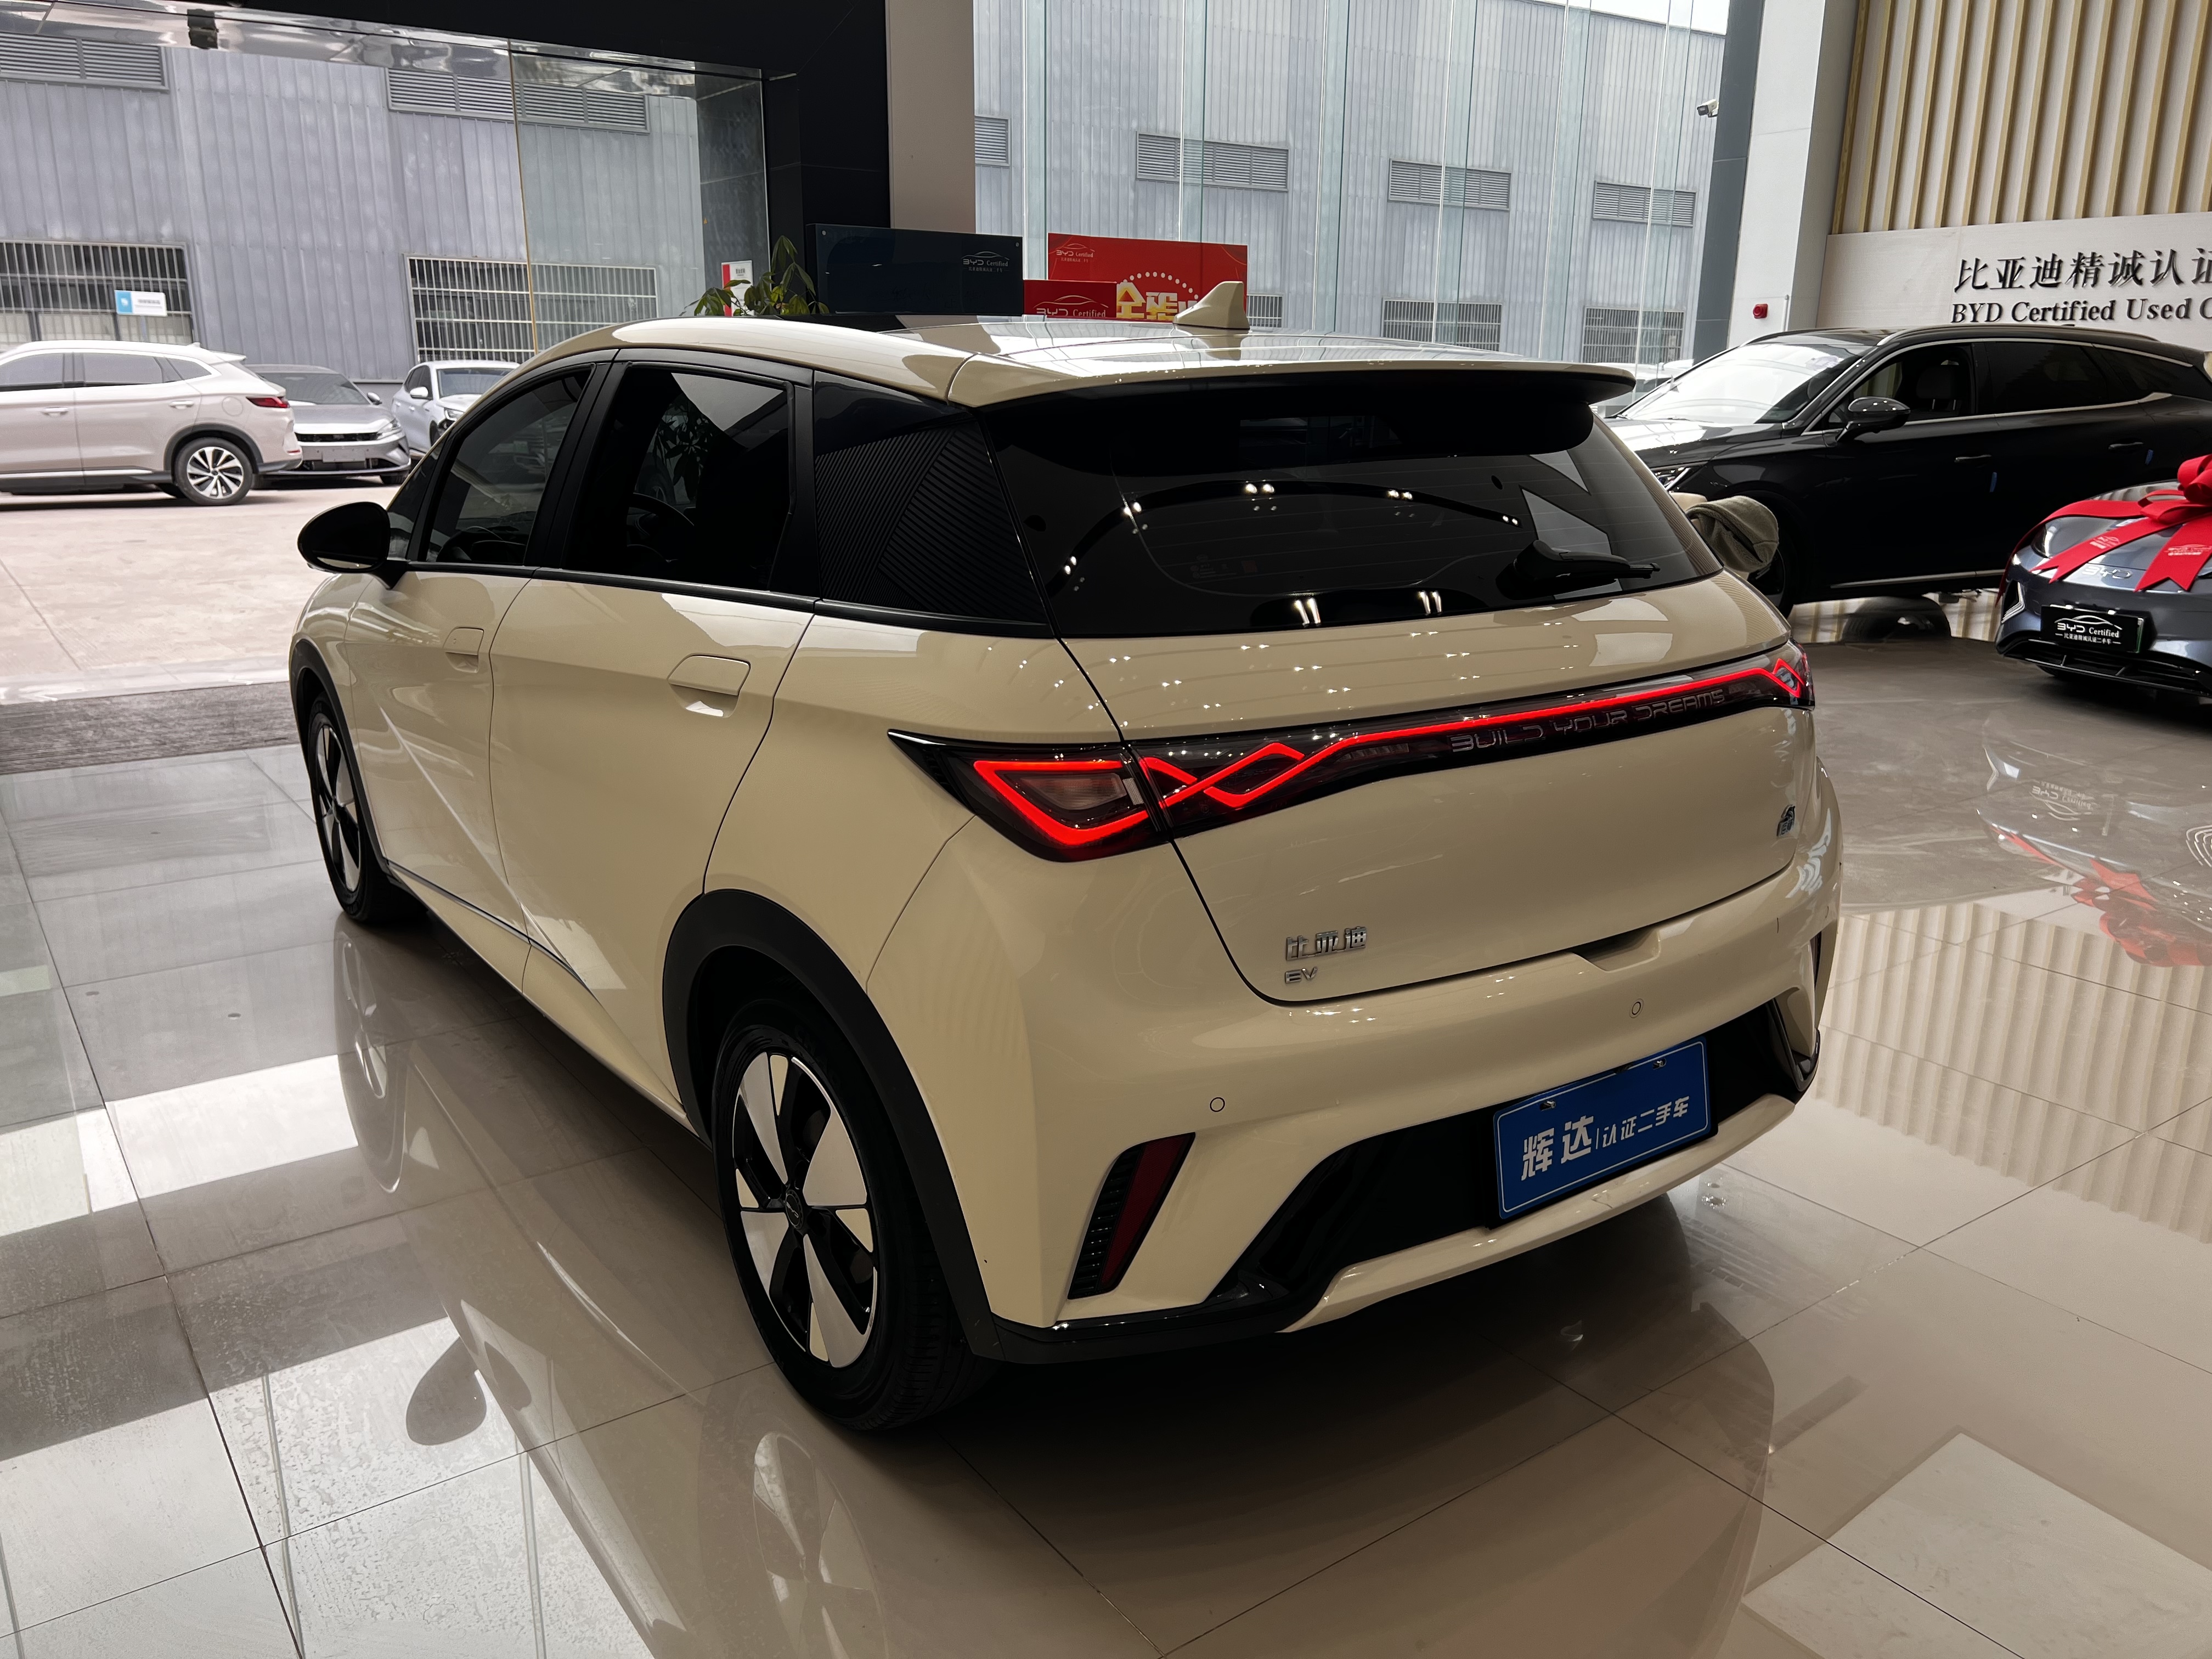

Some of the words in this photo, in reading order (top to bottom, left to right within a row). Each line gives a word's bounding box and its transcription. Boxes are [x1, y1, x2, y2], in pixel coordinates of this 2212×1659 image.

[1951, 302, 2002, 324] BYD
[2011, 300, 2116, 323] Certified
[2126, 298, 2193, 320] Used
[2081, 565, 2133, 580] BYD
[2057, 622, 2085, 633] BYD
[2089, 627, 2119, 638] Certified
[1451, 724, 1545, 753] BUILD
[1553, 709, 1628, 735] YOUR
[1633, 689, 1725, 722] DREAMS
[1286, 926, 1367, 961] 比亚迪
[1285, 966, 1318, 984] EV
[1521, 1115, 1594, 1181] 辉达
[1602, 1096, 1690, 1148] 认证二手车
